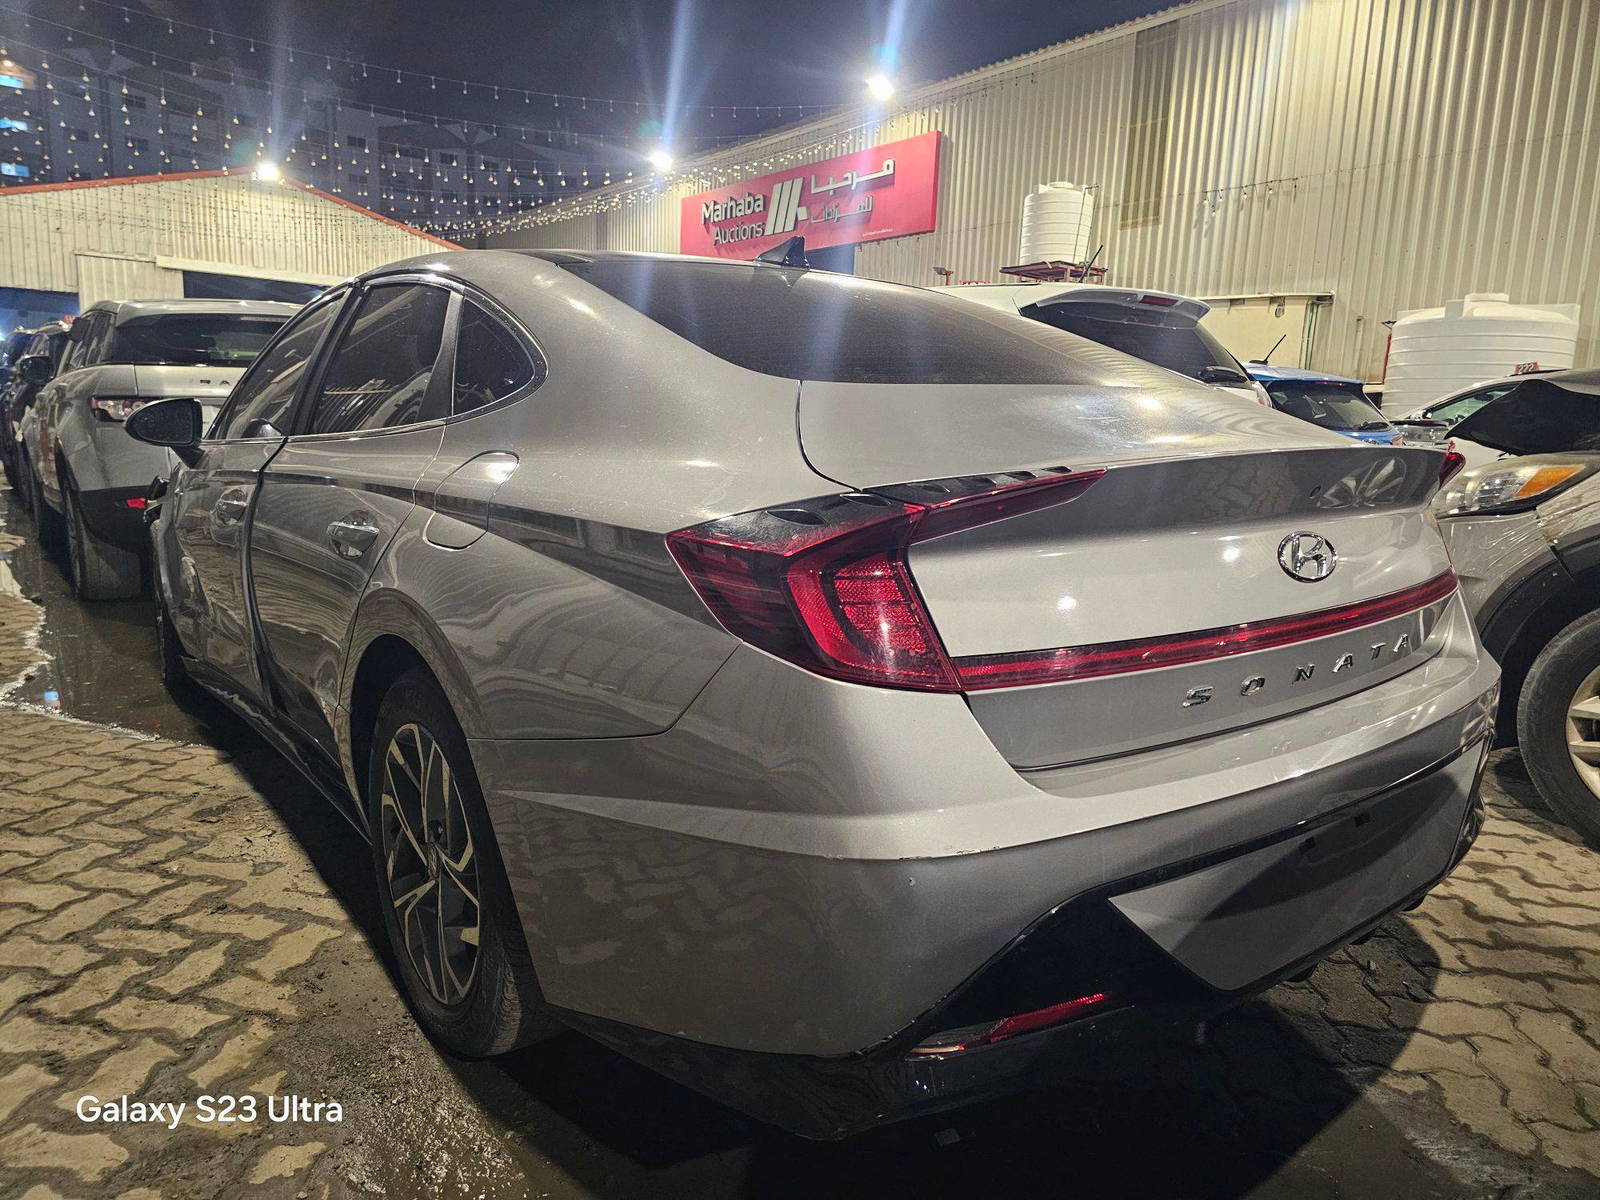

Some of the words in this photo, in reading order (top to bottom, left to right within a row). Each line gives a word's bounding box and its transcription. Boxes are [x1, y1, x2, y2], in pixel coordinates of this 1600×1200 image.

[811, 159, 894, 195] مرحبا
[702, 192, 764, 225] Marhaba
[714, 222, 765, 246] Auctions
[1182, 633, 1409, 708] SONATA
